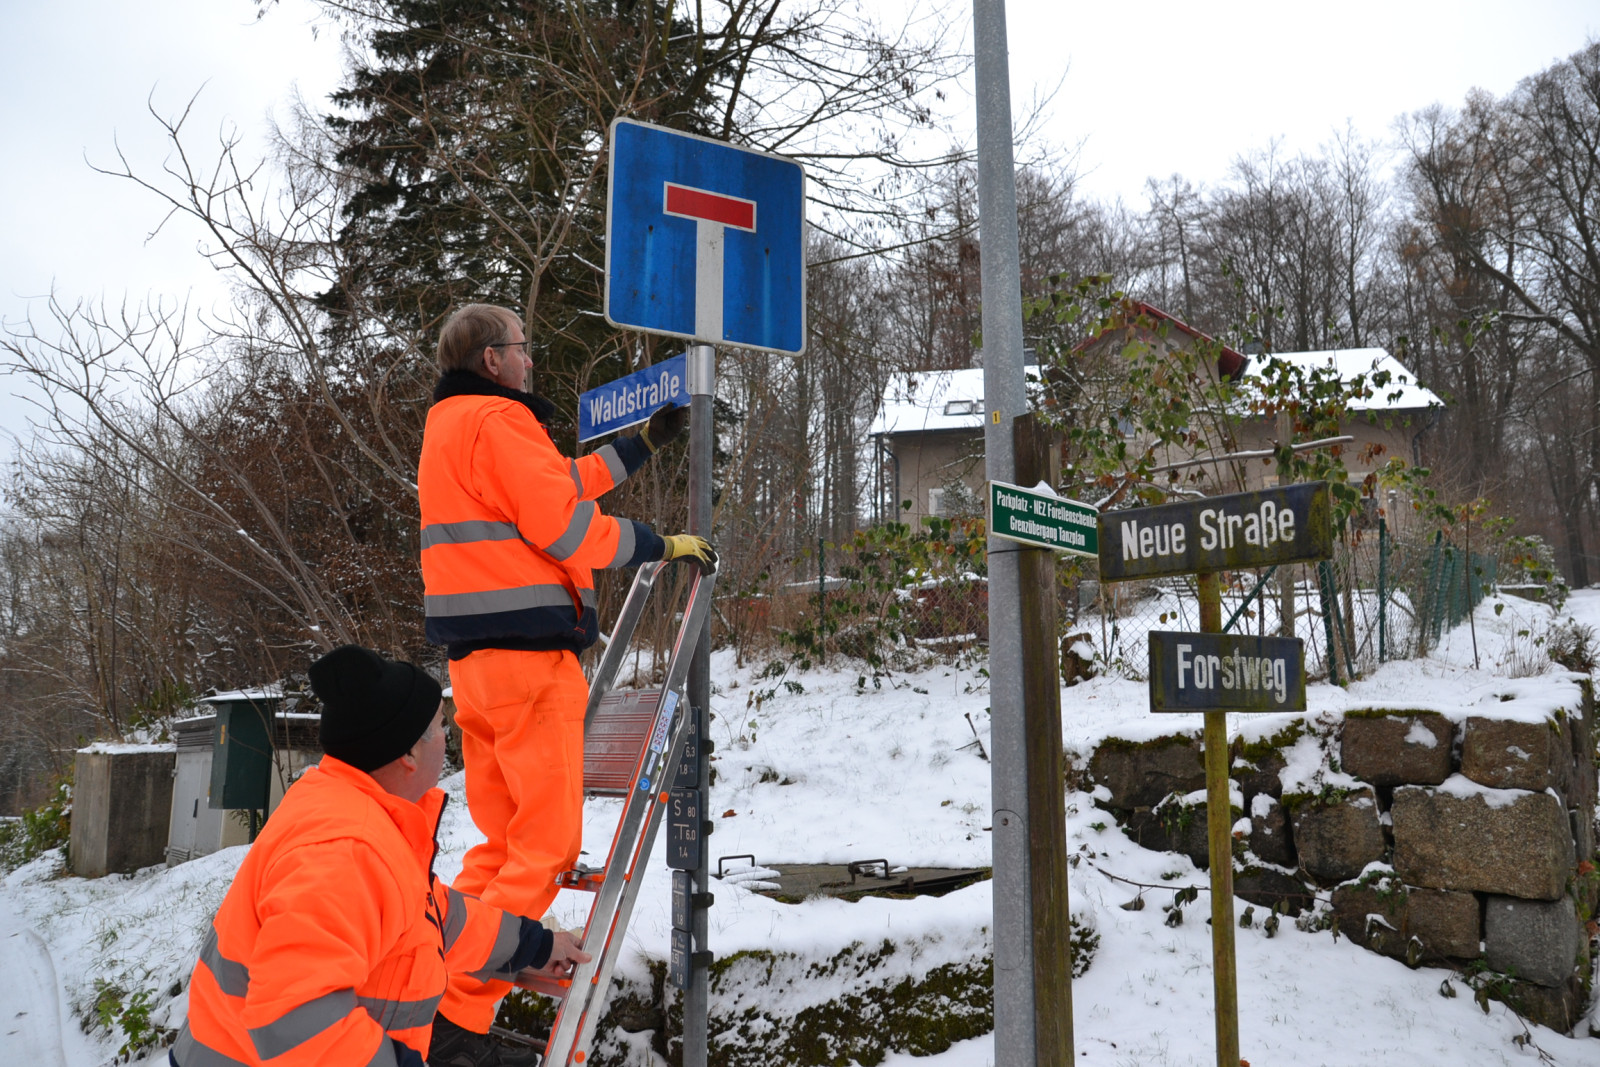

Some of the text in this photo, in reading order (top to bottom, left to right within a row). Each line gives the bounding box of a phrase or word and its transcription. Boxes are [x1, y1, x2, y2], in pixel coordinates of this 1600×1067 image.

[590, 371, 680, 427] Waldstraße
[996, 490, 1028, 513] Parkplatz
[1034, 499, 1047, 517] NEZ
[1047, 503, 1097, 529] Forellenschenke
[1010, 515, 1086, 547] Grenzübergang Tanzplan
[1121, 500, 1296, 561] Neue Straße
[1176, 643, 1287, 704] Forstweg
[674, 799, 696, 818] S 80
